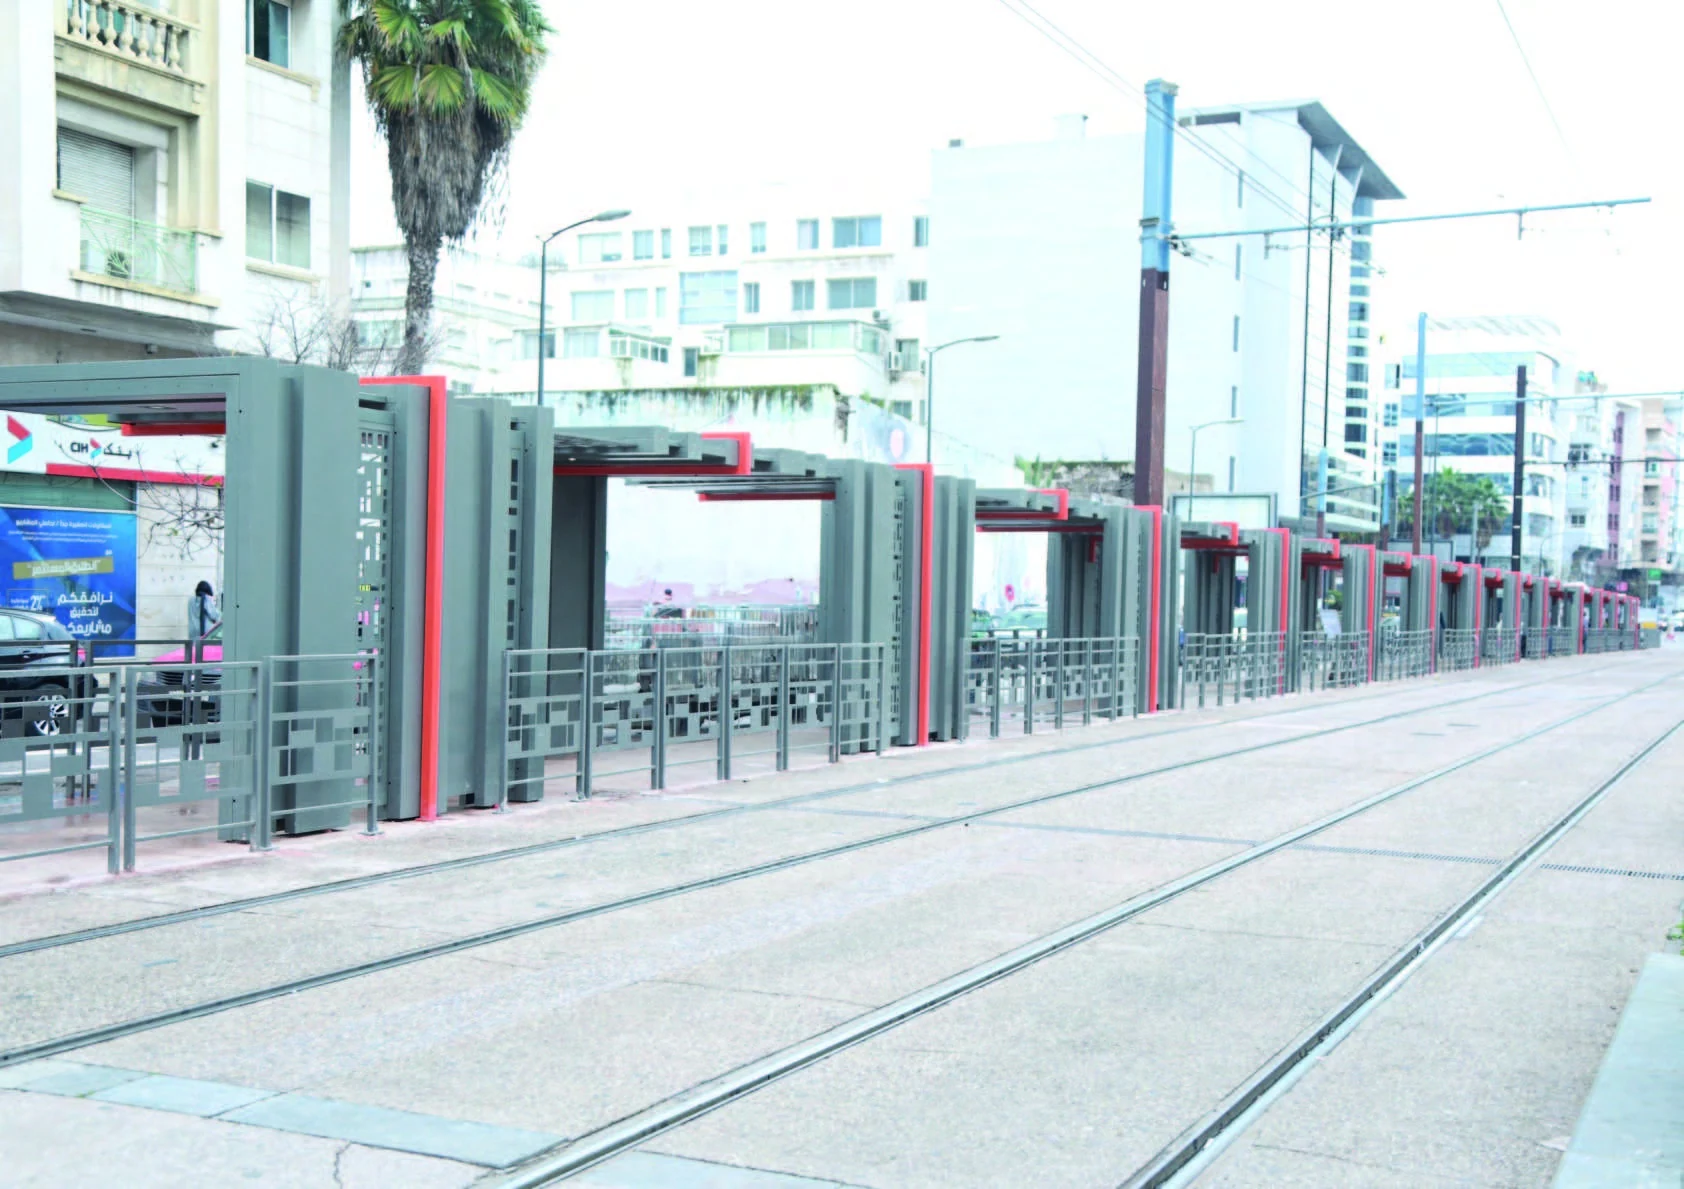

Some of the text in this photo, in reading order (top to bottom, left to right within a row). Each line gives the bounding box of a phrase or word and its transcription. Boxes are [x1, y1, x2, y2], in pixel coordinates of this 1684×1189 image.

[70, 442, 89, 453] CIH
[103, 442, 132, 460] بنك
[57, 591, 113, 605] نرافقكم
[69, 606, 99, 618] لتحقيق
[64, 619, 112, 637] مشاريعك
